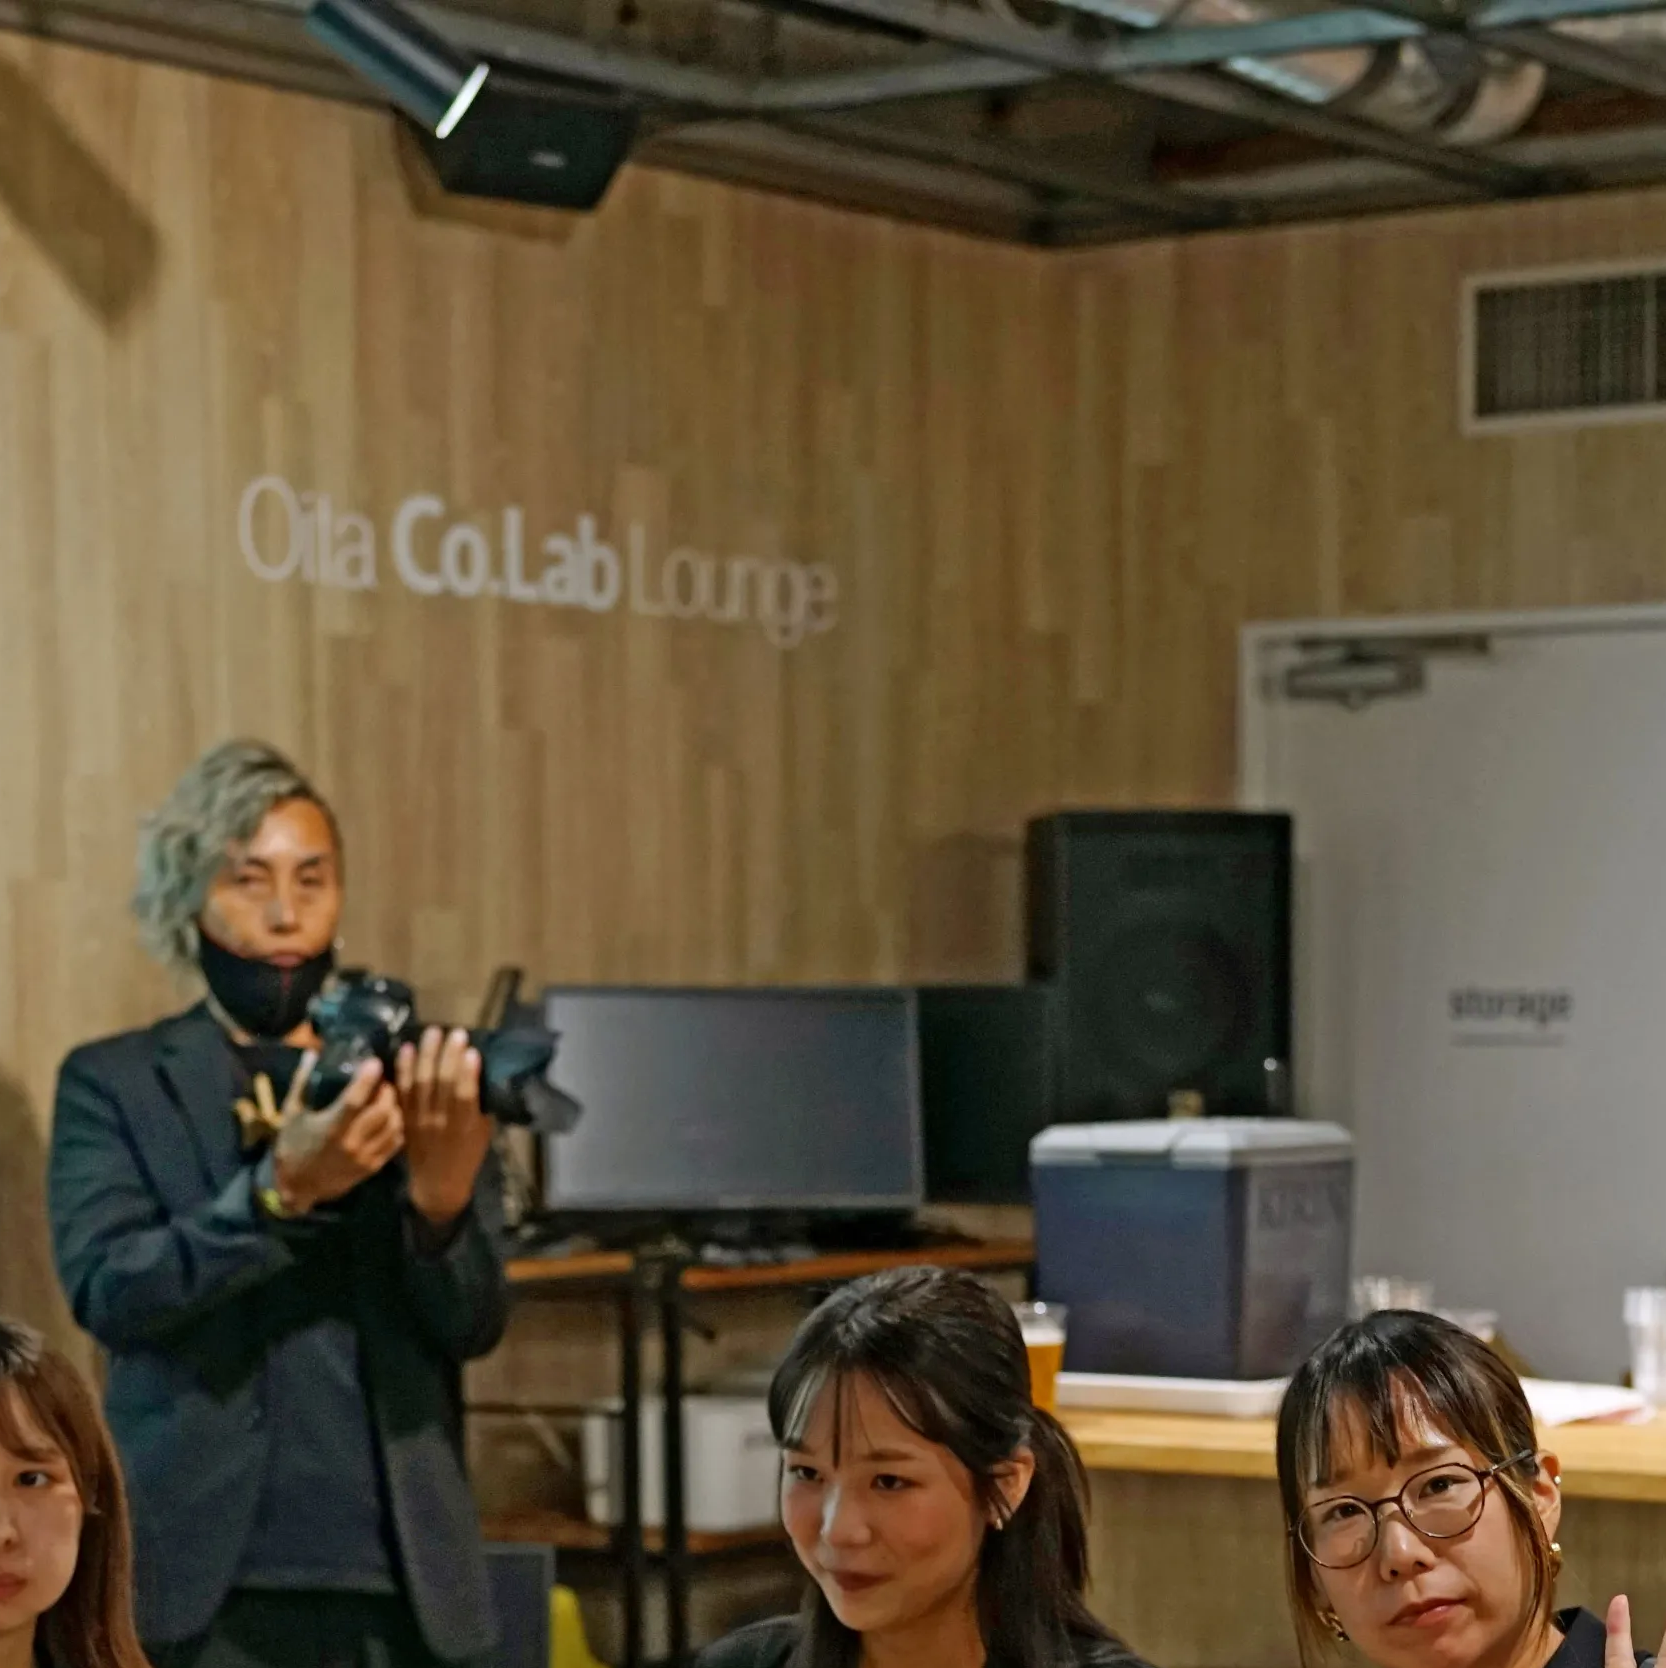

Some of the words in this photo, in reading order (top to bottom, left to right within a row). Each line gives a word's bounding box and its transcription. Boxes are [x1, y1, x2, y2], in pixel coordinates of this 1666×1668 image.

[390, 494, 622, 613] Co.Lab
[628, 524, 837, 650] Lounge
[1447, 985, 1574, 1031] storage
